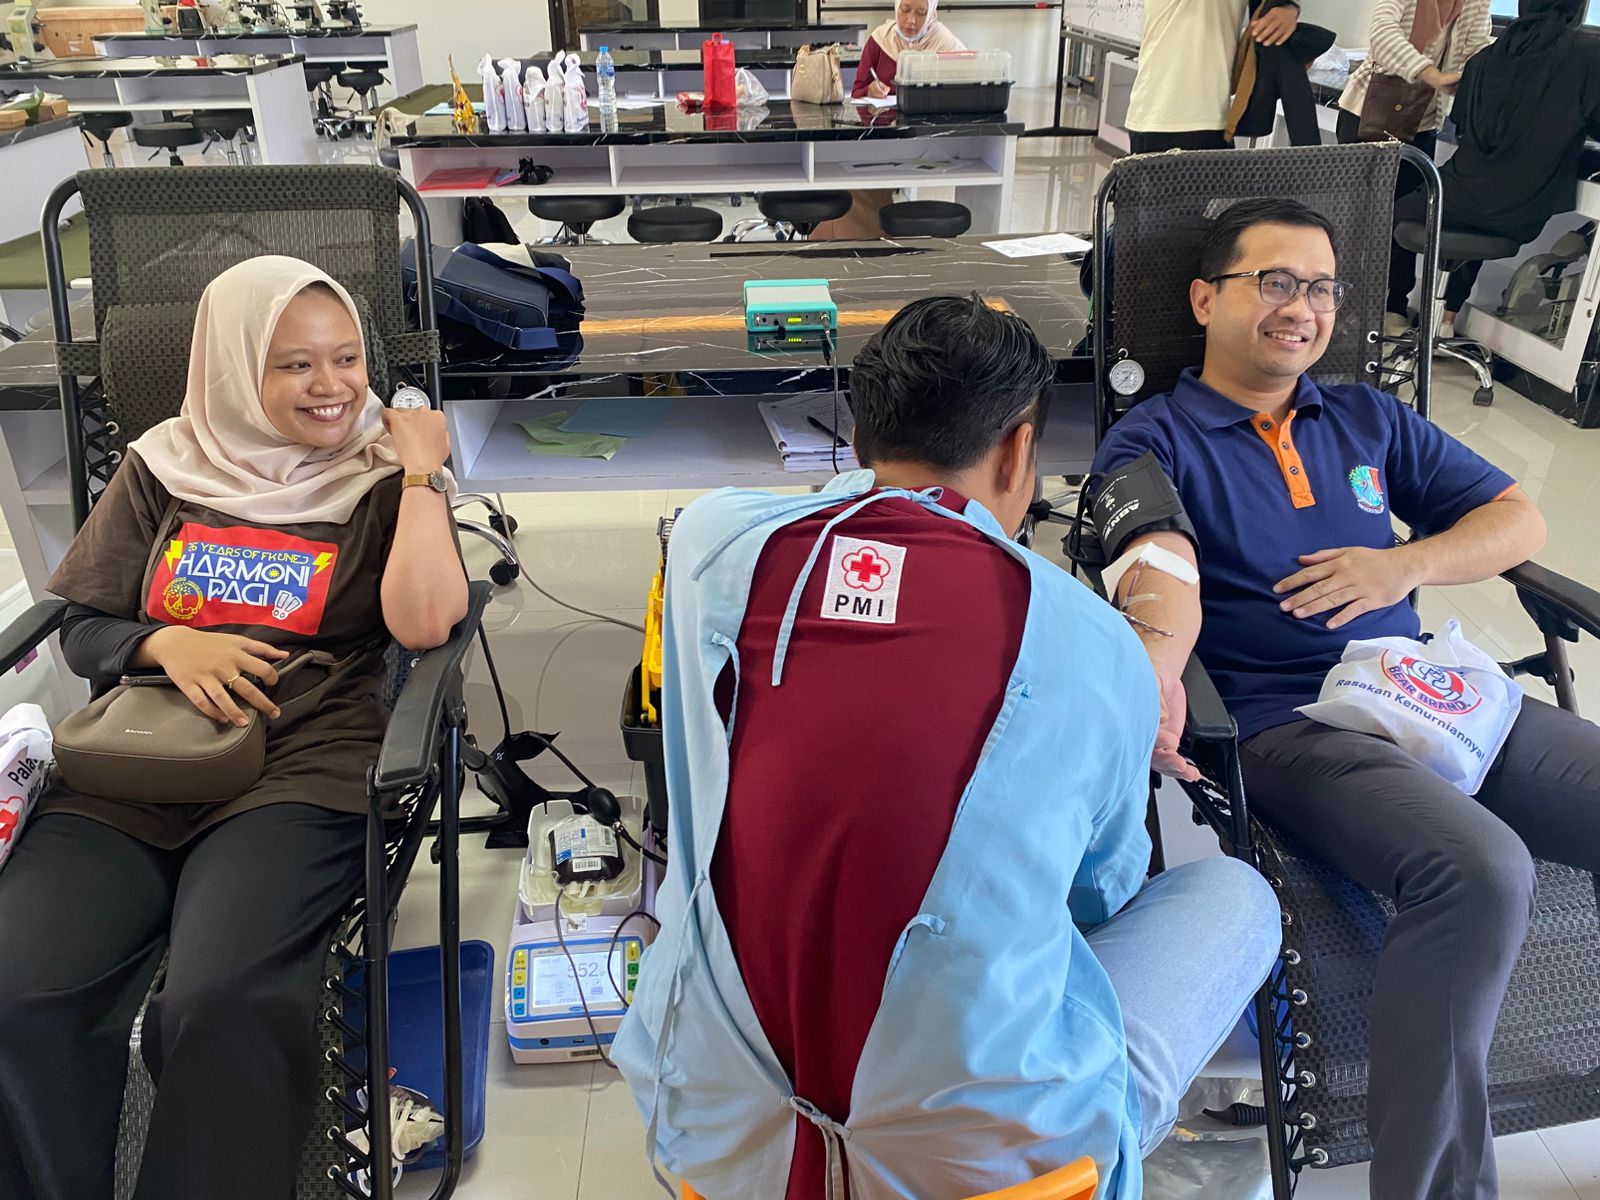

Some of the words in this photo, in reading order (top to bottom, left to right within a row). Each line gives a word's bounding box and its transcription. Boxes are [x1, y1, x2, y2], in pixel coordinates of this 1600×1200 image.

[200, 542, 242, 558] YEARS
[242, 548, 261, 560] OF
[175, 554, 311, 588] HARMONI
[206, 578, 270, 607] PAGI
[834, 594, 884, 617] PMI
[1388, 665, 1418, 696] BEAR
[1419, 692, 1468, 712] BRAND
[1335, 679, 1392, 698] Rasakan
[1394, 693, 1486, 763] Kemurniannya!
